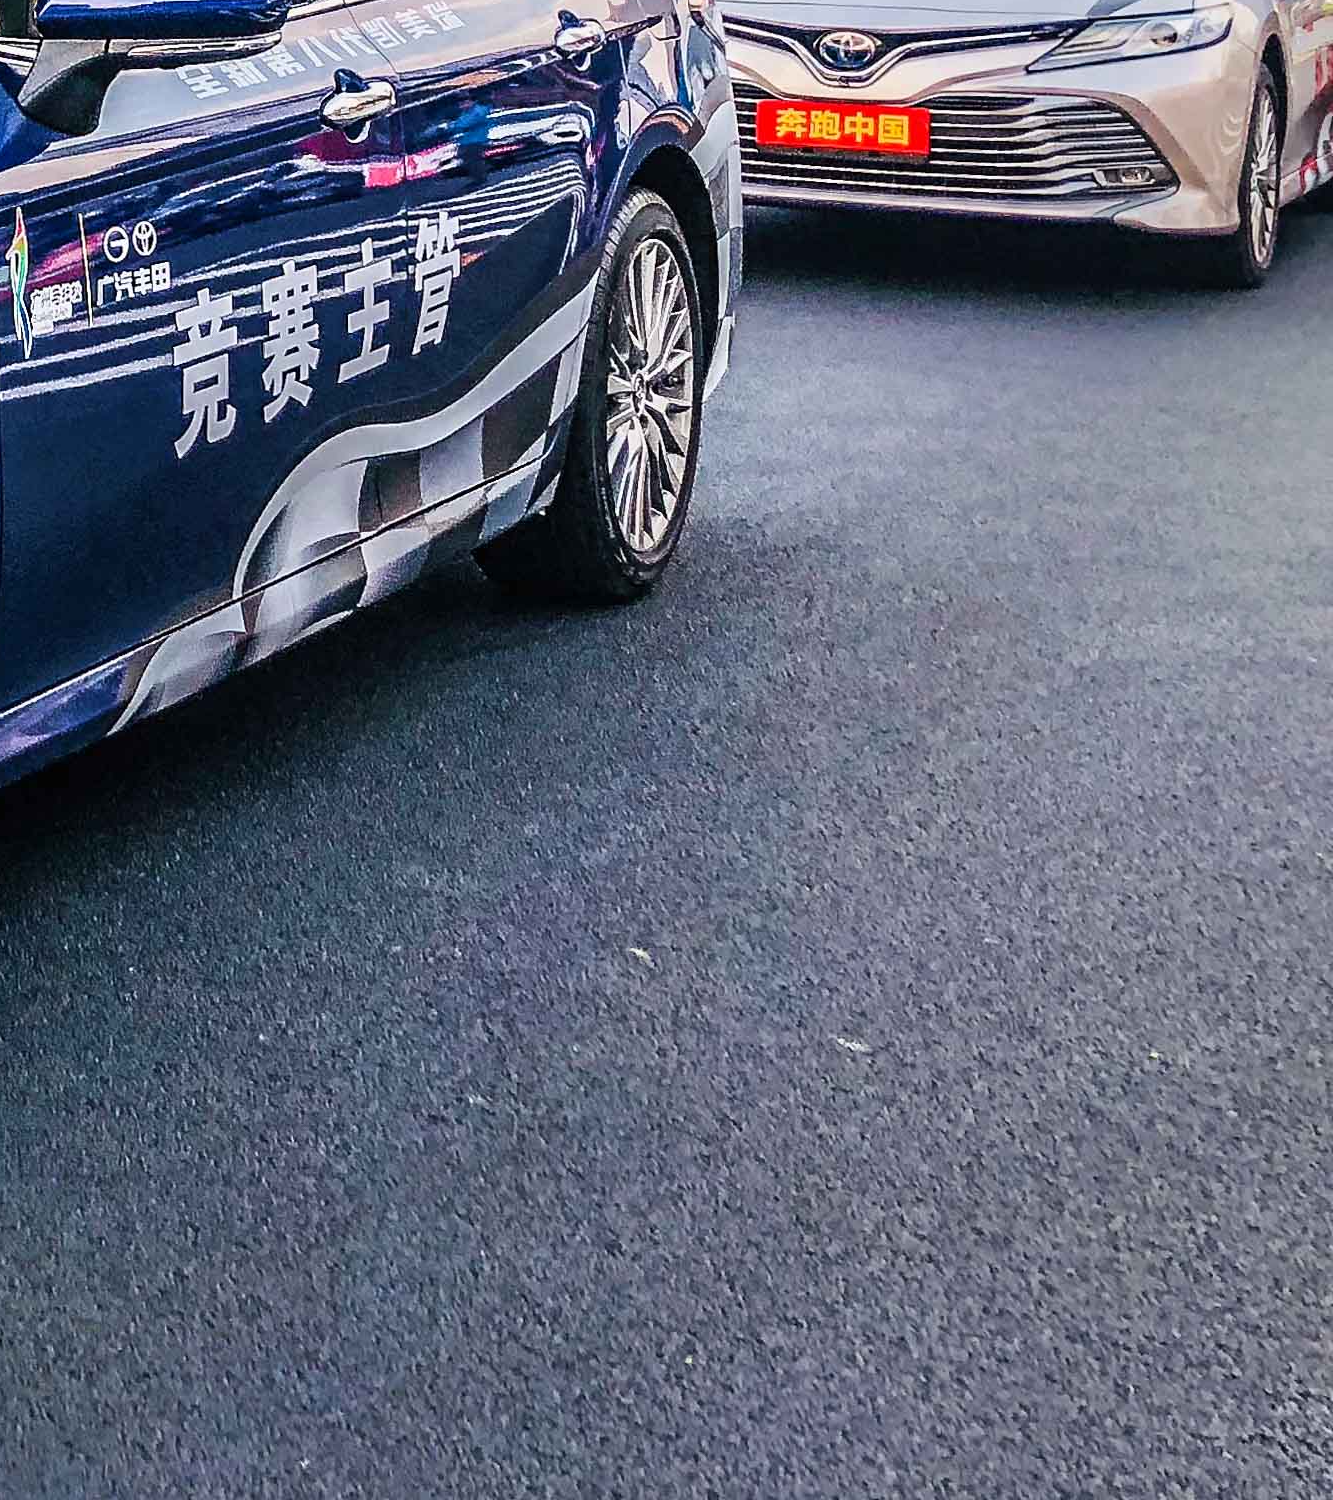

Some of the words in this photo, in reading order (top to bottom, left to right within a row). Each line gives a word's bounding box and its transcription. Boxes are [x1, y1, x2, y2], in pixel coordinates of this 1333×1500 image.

[776, 108, 909, 145] 奔跑中国
[97, 262, 171, 306] 广汽丰田
[173, 211, 460, 460] 竞赛主管
